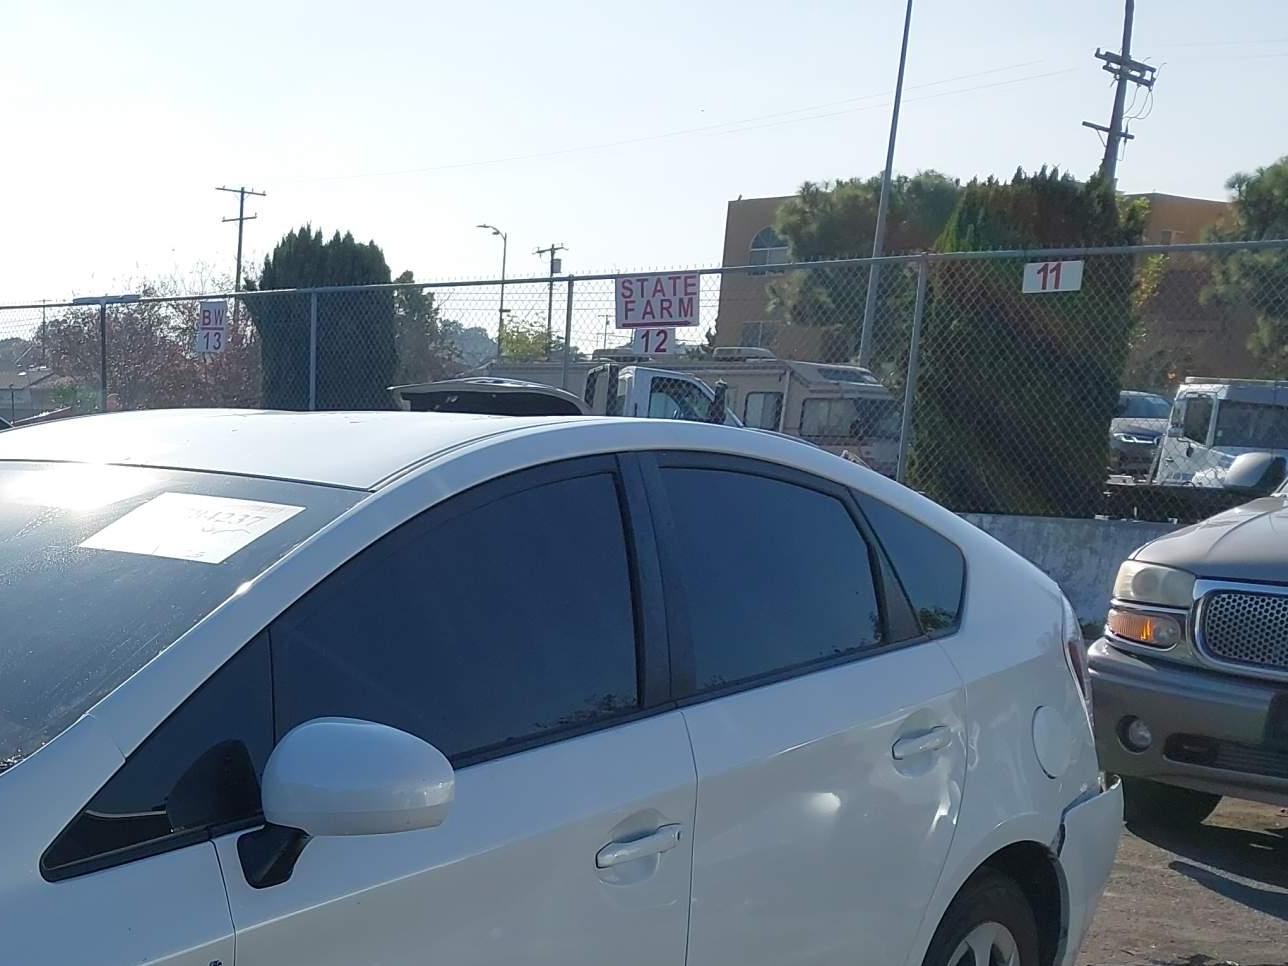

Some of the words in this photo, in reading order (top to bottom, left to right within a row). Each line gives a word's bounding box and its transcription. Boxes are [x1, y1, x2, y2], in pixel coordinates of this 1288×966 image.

[621, 275, 697, 299] STATE
[1037, 263, 1062, 290] 11
[202, 309, 224, 326] BW
[624, 297, 694, 320] FARM
[203, 331, 222, 350] 13
[641, 329, 668, 353] 12
